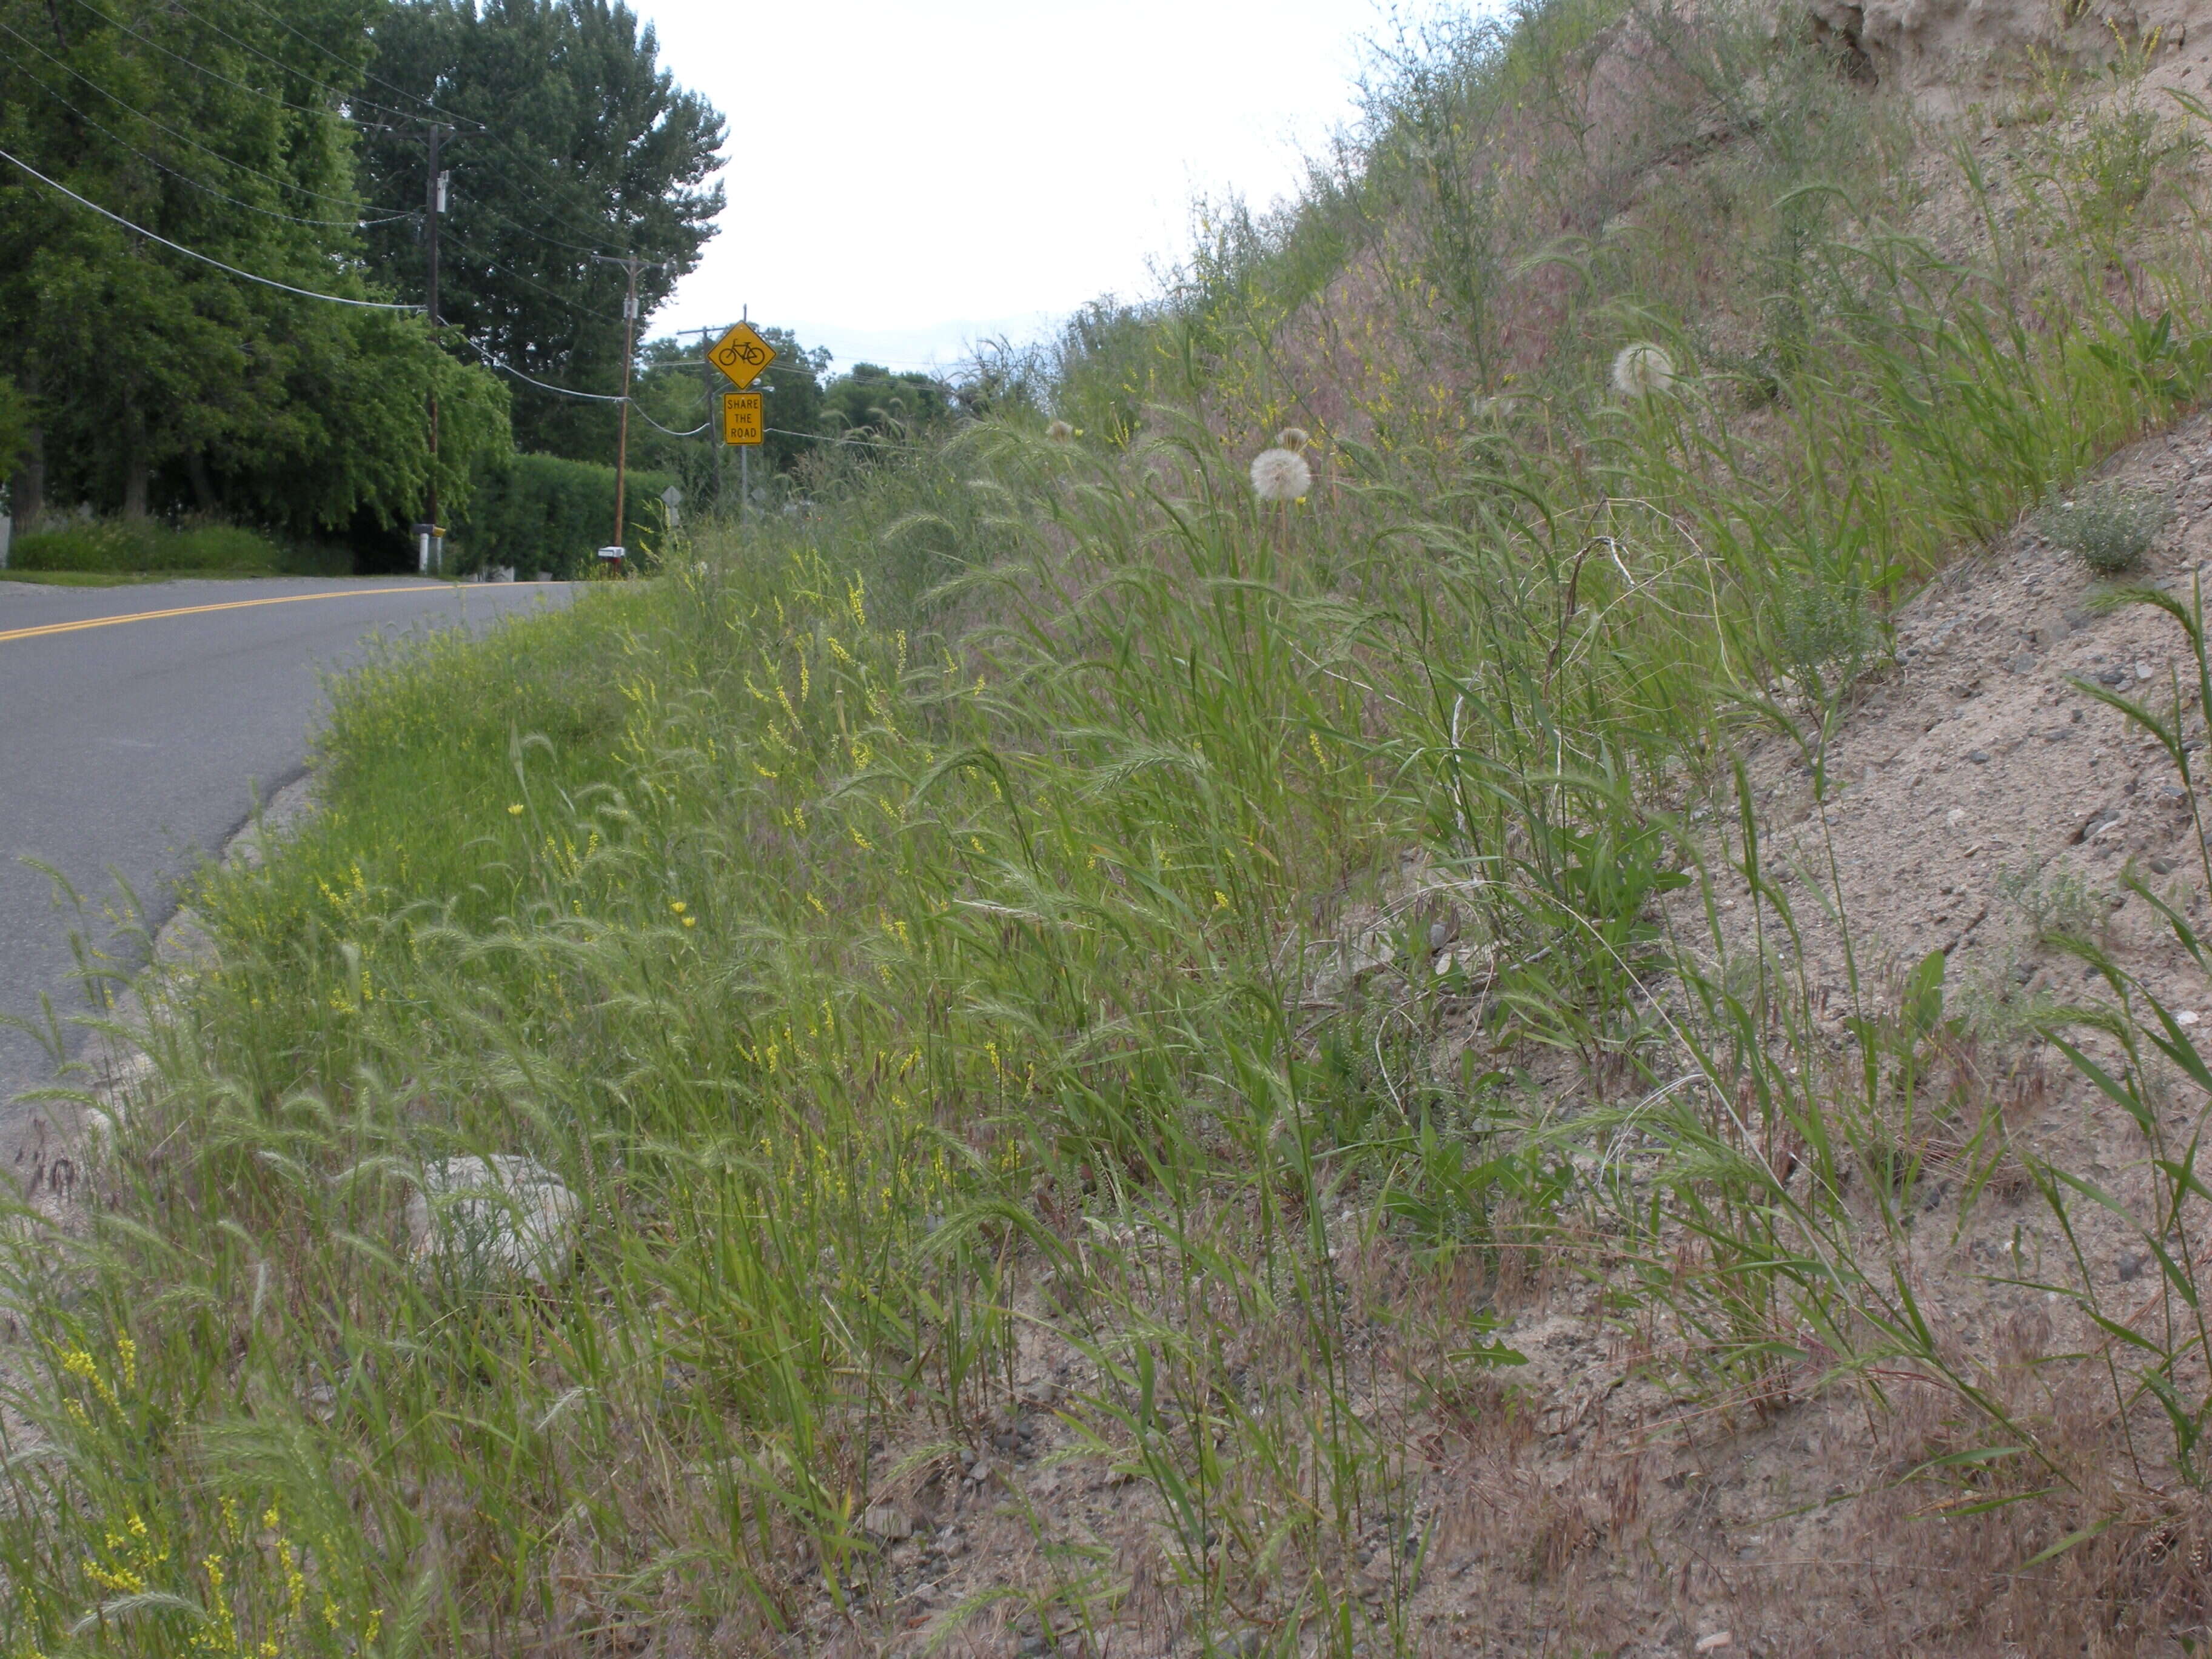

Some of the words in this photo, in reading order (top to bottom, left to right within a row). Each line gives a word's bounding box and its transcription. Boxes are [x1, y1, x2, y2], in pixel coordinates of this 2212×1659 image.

[728, 399, 758, 409] SHARE
[734, 414, 752, 423] THE
[731, 428, 756, 438] ROAD
